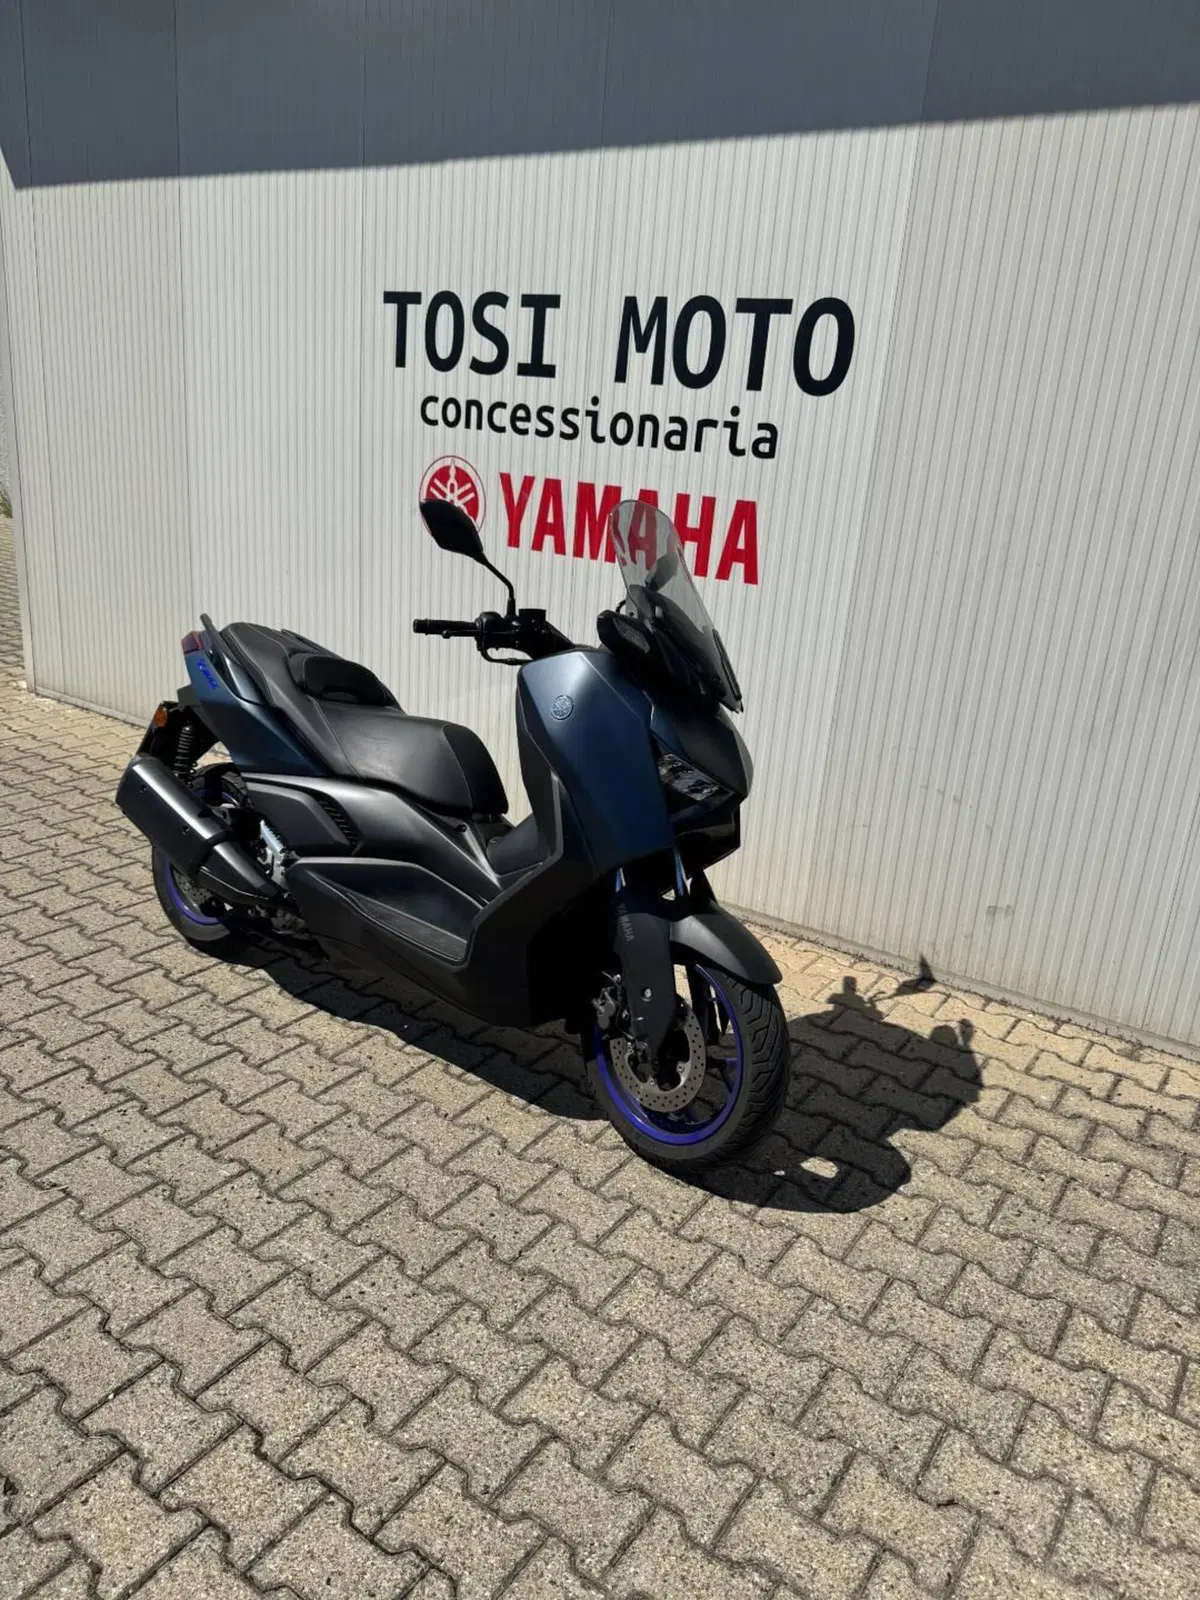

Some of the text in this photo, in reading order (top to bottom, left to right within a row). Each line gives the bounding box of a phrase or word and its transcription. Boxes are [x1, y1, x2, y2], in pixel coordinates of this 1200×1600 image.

[383, 290, 855, 397] TOSI MOTO
[420, 395, 779, 460] concessionaria
[499, 472, 759, 586] YAMAHA
